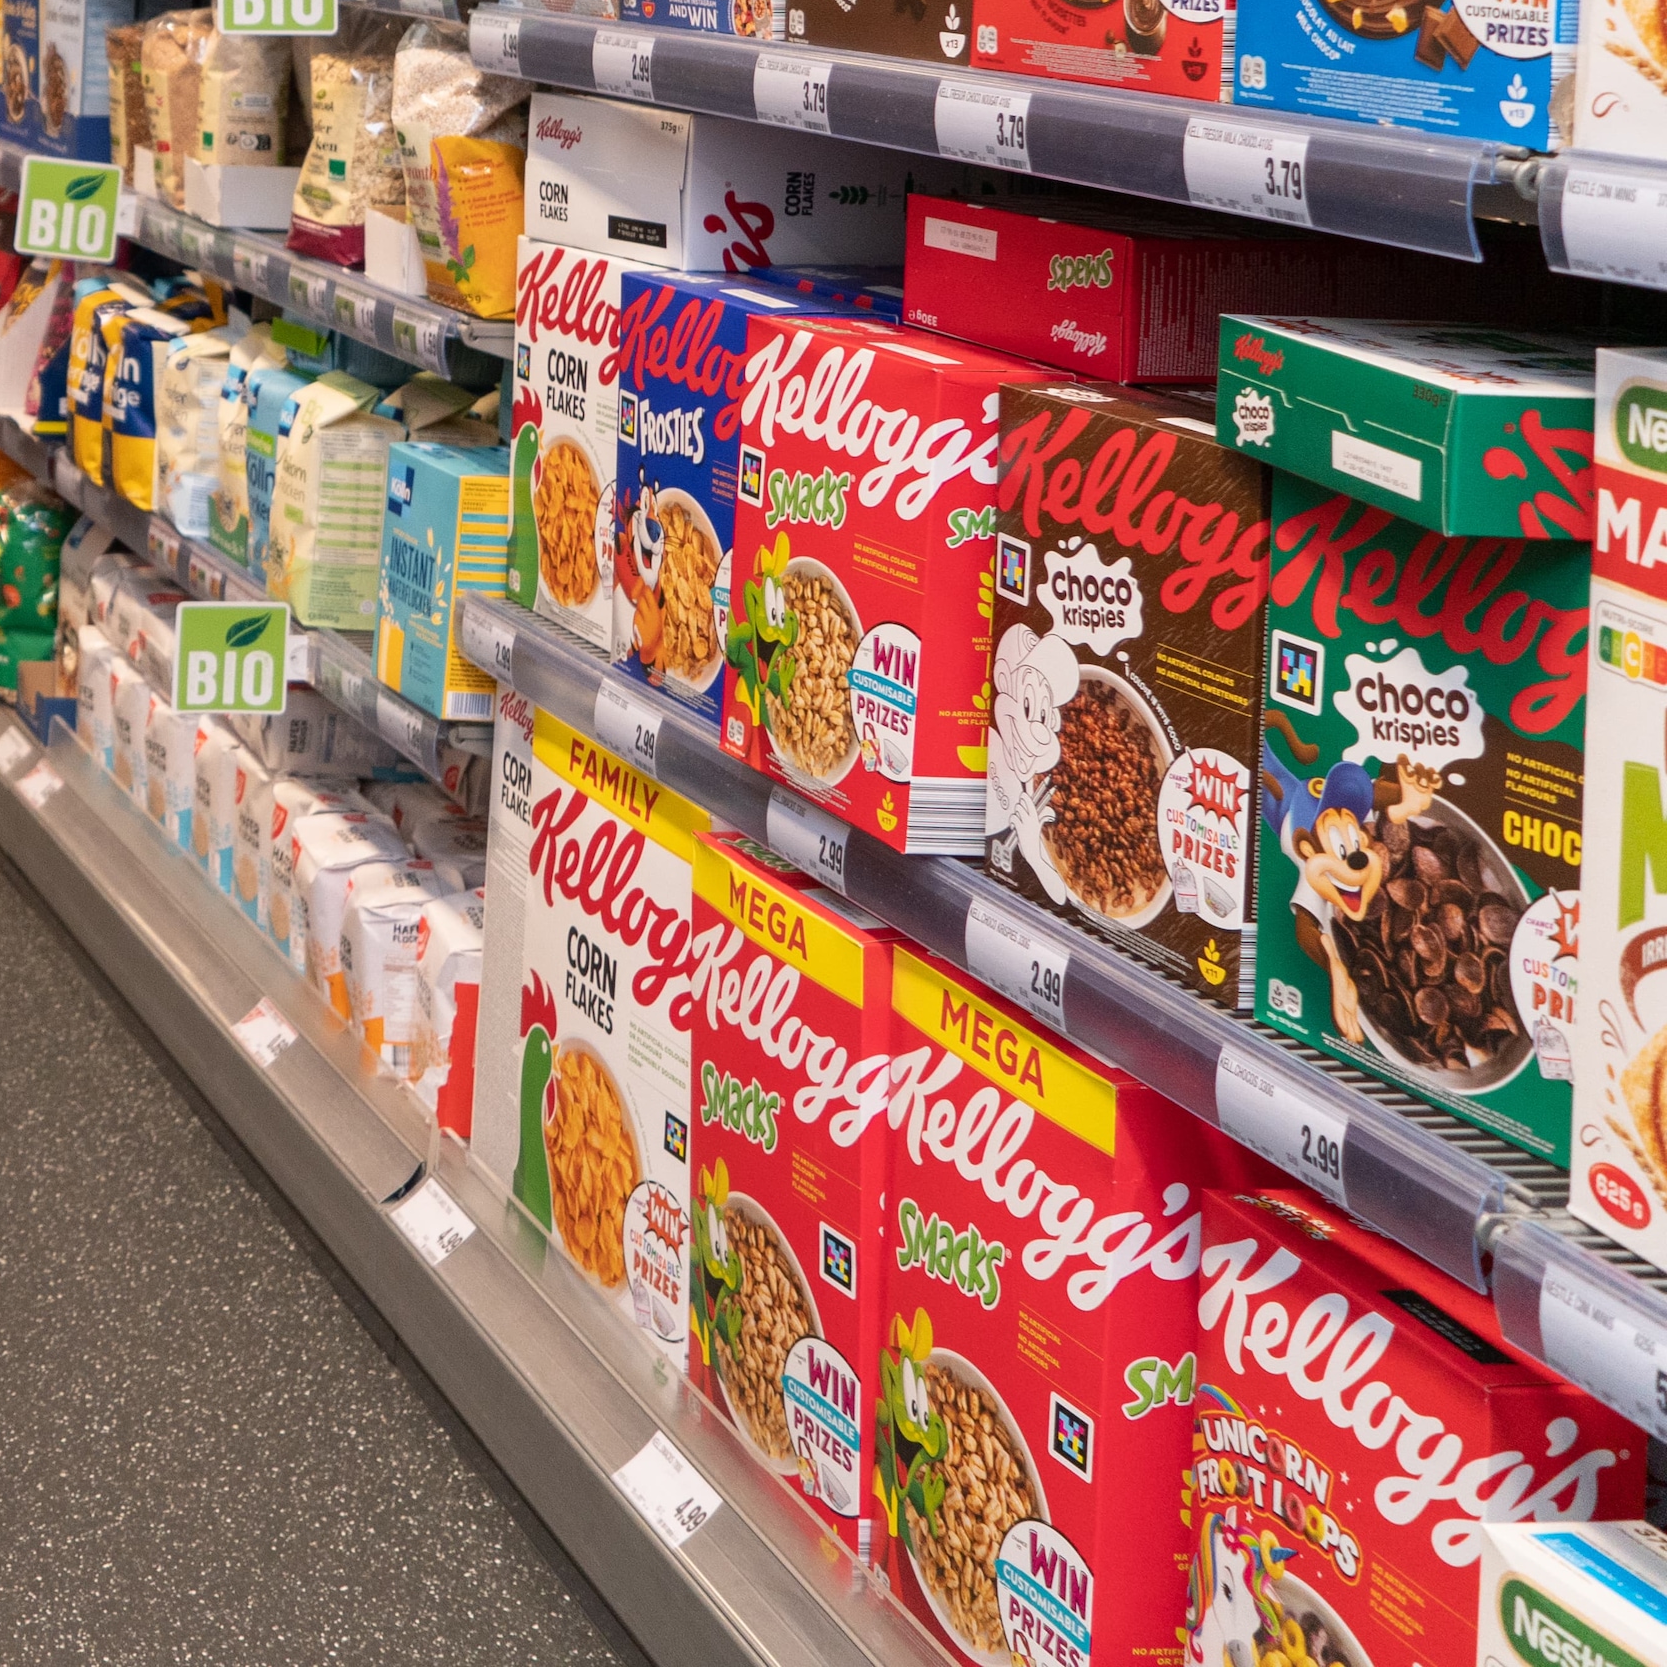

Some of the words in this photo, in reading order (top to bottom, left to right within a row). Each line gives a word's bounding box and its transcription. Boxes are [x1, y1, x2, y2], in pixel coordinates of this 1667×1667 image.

[669, 4, 688, 19] AND
[690, 6, 717, 29] WIN
[1465, 6, 1549, 24] CUSTOMISABLE
[1486, 23, 1548, 48] PRIZES
[632, 53, 650, 82] 2.99
[996, 114, 1024, 149] 3.79
[29, 198, 105, 252] BIO
[188, 650, 275, 706] BIO
[873, 635, 915, 686] WIN
[856, 698, 911, 735] PRIZES
[1355, 673, 1470, 723] choco
[1372, 717, 1461, 749] krispies
[568, 738, 659, 823] FAMILY
[729, 874, 809, 959] MEGA
[1302, 1126, 1341, 1181] 2.99
[808, 1346, 856, 1419] WIN
